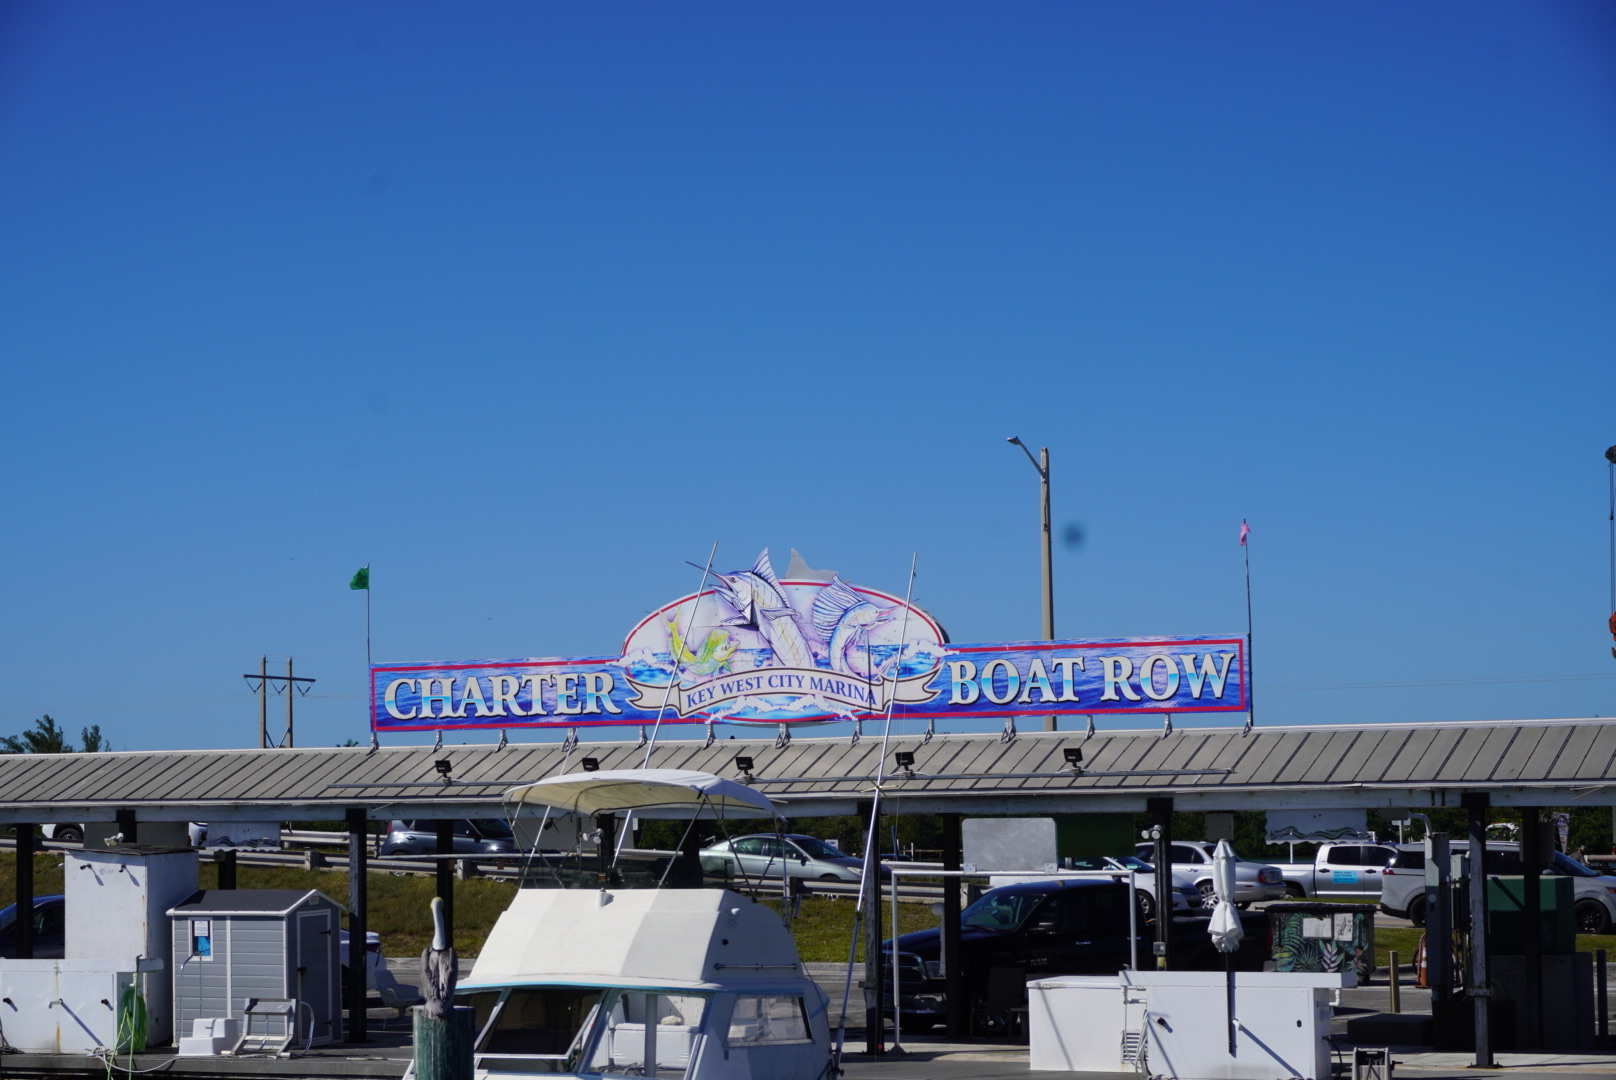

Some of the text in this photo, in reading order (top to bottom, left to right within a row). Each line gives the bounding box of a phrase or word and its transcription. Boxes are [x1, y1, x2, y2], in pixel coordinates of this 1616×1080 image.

[384, 652, 1236, 720] CHARTER BOAT ROW
[687, 675, 877, 708] KEY WEST CITY MARINA
